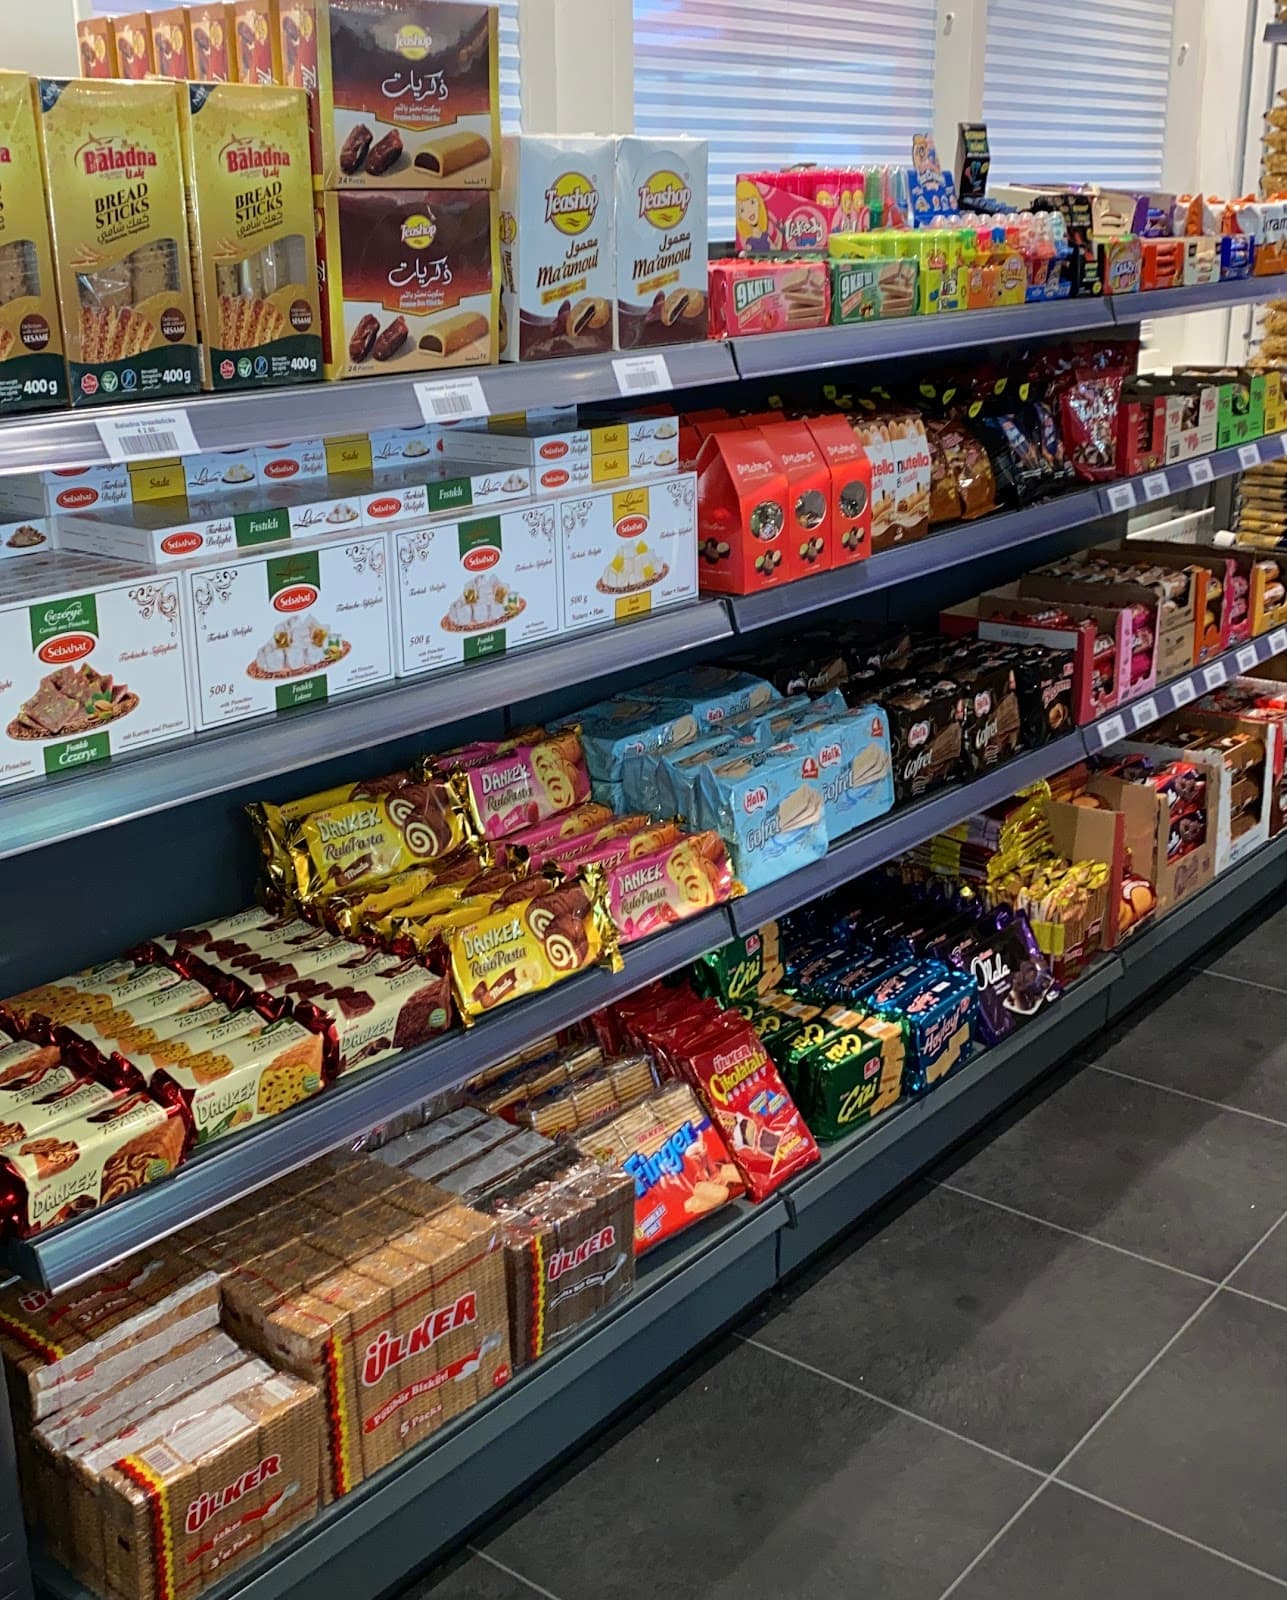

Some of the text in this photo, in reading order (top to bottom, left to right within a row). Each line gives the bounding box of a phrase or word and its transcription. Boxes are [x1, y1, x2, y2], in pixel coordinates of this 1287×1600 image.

[84, 146, 157, 175] Baladna
[227, 147, 290, 173] Baladna
[95, 182, 148, 213] BREAD
[235, 181, 282, 210] BREAD
[236, 196, 283, 224] STICKS
[545, 186, 599, 223] Teashop
[639, 186, 691, 218] Teashop
[96, 198, 149, 229] STICKS
[401, 224, 437, 242] Teashop
[388, 255, 453, 288] ذكريات
[537, 250, 599, 288] Ma'amoul
[632, 243, 691, 280] Ma'amoul
[872, 458, 894, 476] tella
[897, 451, 929, 474] nutella
[47, 642, 87, 658] Sebahat
[209, 684, 226, 697] 500
[820, 745, 841, 763] Halk
[481, 763, 531, 795] DANKEK
[745, 788, 768, 808] Halk
[317, 806, 383, 843] DANKEK
[746, 812, 781, 853] Gofret
[463, 917, 525, 961] DANKEK
[340, 1016, 395, 1052] DANKEK
[713, 1044, 752, 1074] ÜLKER
[198, 1081, 258, 1124] DANKEK
[623, 1119, 699, 1199] Finger
[32, 1169, 99, 1219] DANKEK
[547, 1225, 616, 1282] ÜLKER
[362, 1290, 478, 1387] ÜLKER
[185, 1454, 282, 1534] ÜLKER
